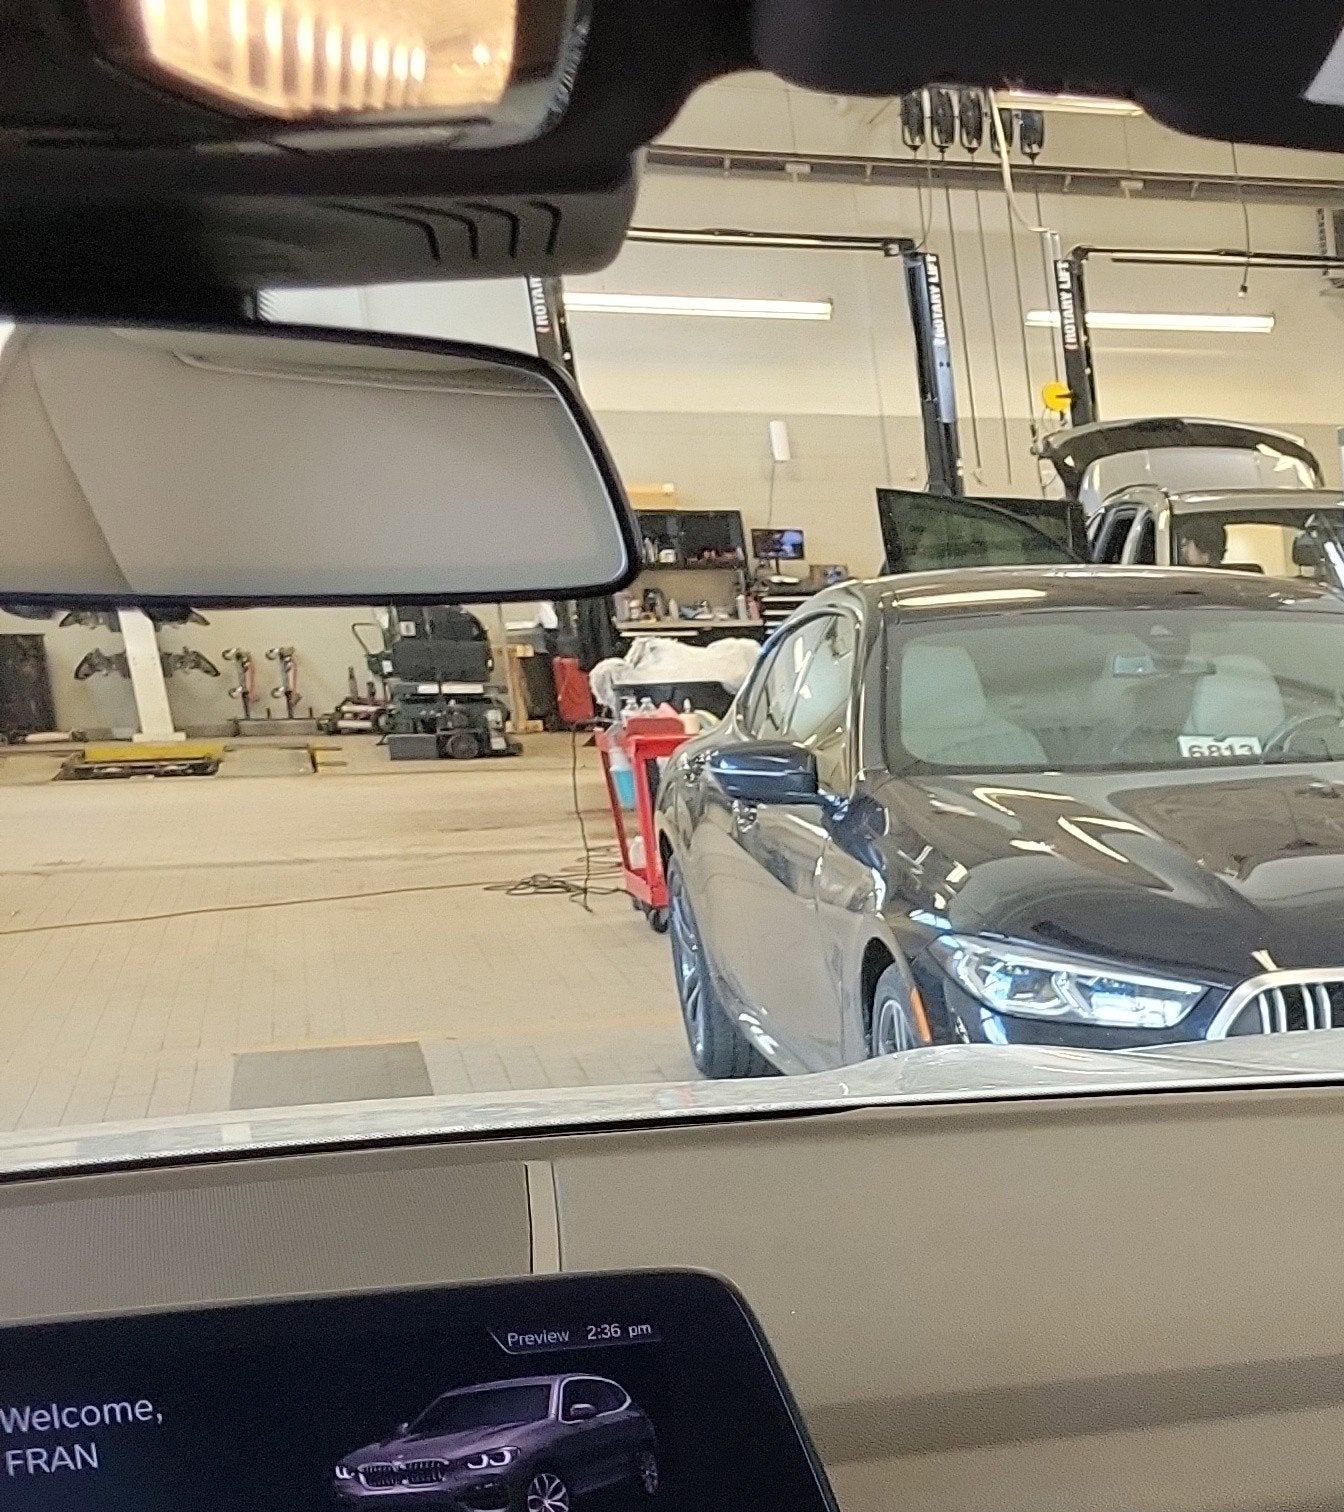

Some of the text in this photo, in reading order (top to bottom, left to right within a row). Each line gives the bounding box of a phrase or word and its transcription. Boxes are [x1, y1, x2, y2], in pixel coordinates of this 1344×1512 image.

[1058, 290, 1078, 344] ROTARY
[507, 1323, 652, 1347] Preview 2:36 pm
[0, 1400, 163, 1434] Welcome,
[5, 1442, 99, 1477] FRAN
